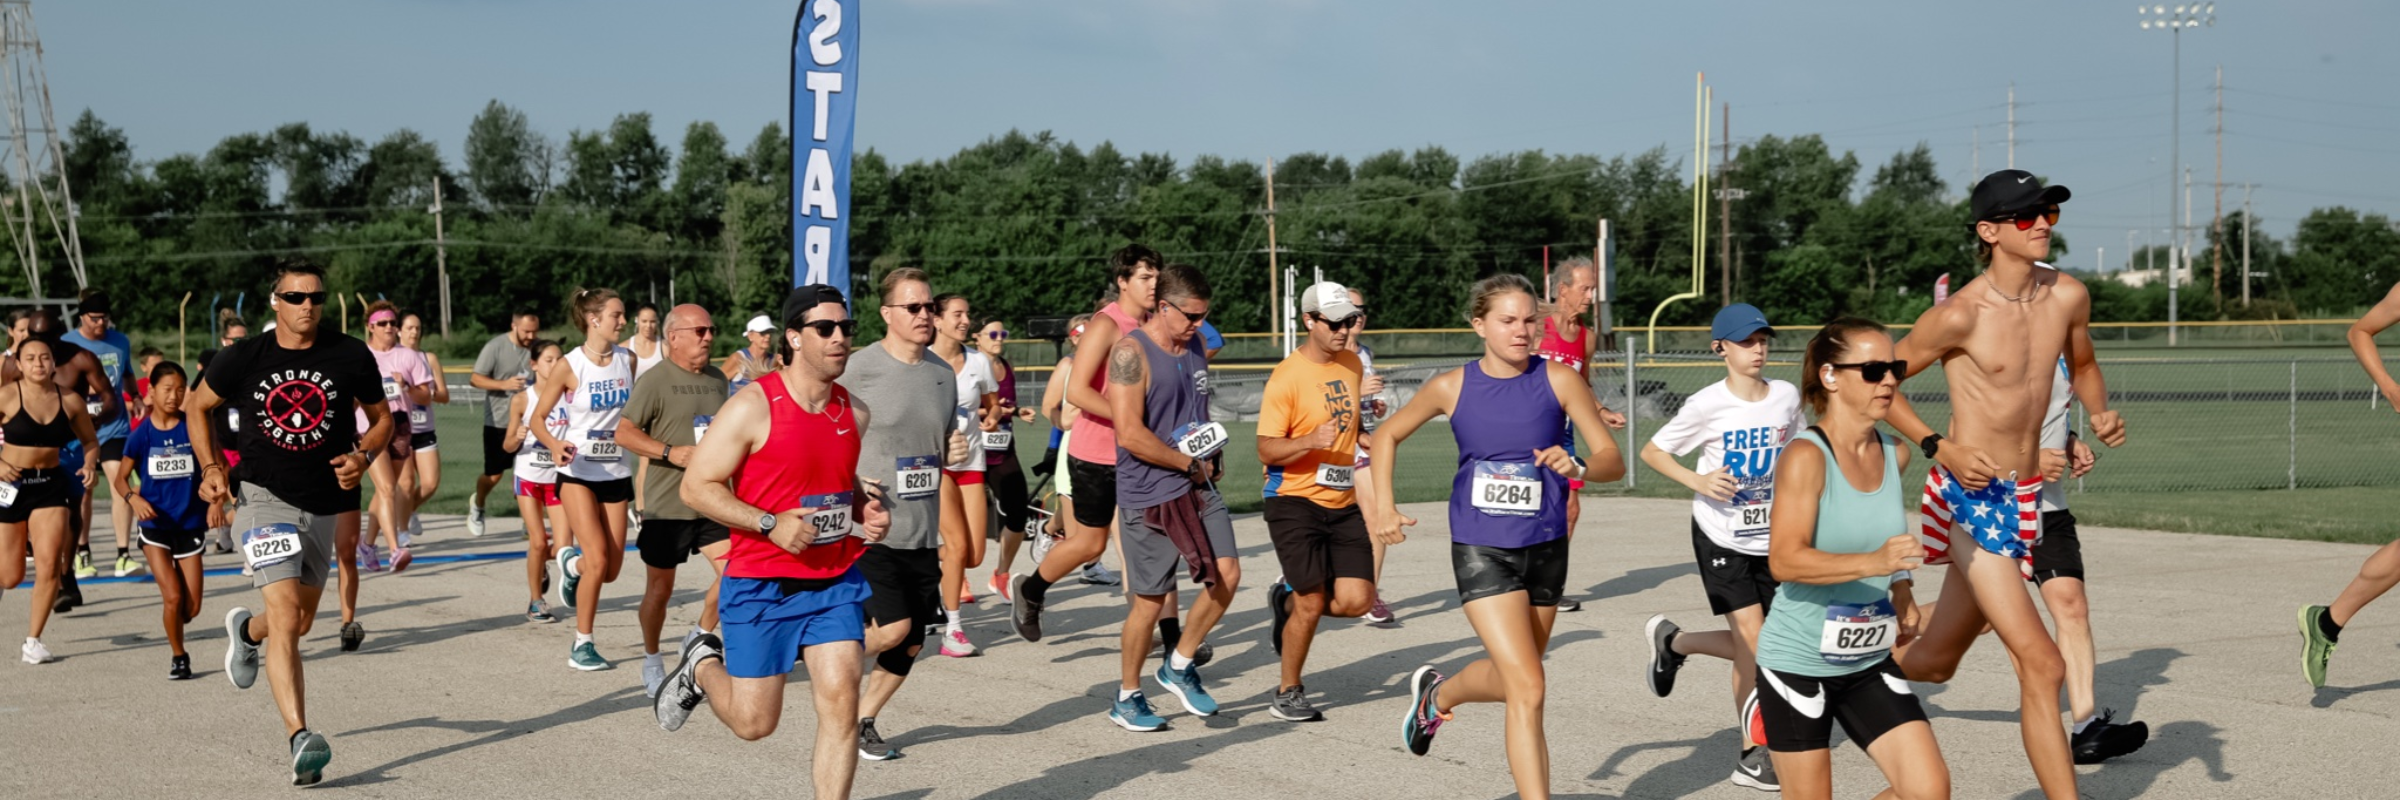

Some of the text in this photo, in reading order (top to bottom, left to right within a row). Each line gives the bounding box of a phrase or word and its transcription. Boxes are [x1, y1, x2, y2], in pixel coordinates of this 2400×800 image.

[254, 369, 337, 401] STRONGER
[591, 388, 629, 410] RUN
[256, 409, 335, 444] TOGETHER
[592, 443, 617, 454] 6123
[987, 434, 1008, 445] 6287
[1187, 426, 1217, 454] 6257
[156, 459, 187, 472] 6233
[1723, 447, 1783, 478] RU
[906, 472, 932, 489] 6281
[1325, 468, 1352, 482] 6304
[1484, 483, 1532, 505] 6264
[812, 512, 845, 533] 6242
[1743, 508, 1770, 525] 621
[252, 538, 292, 558] 6226
[1837, 624, 1887, 649] 6227
